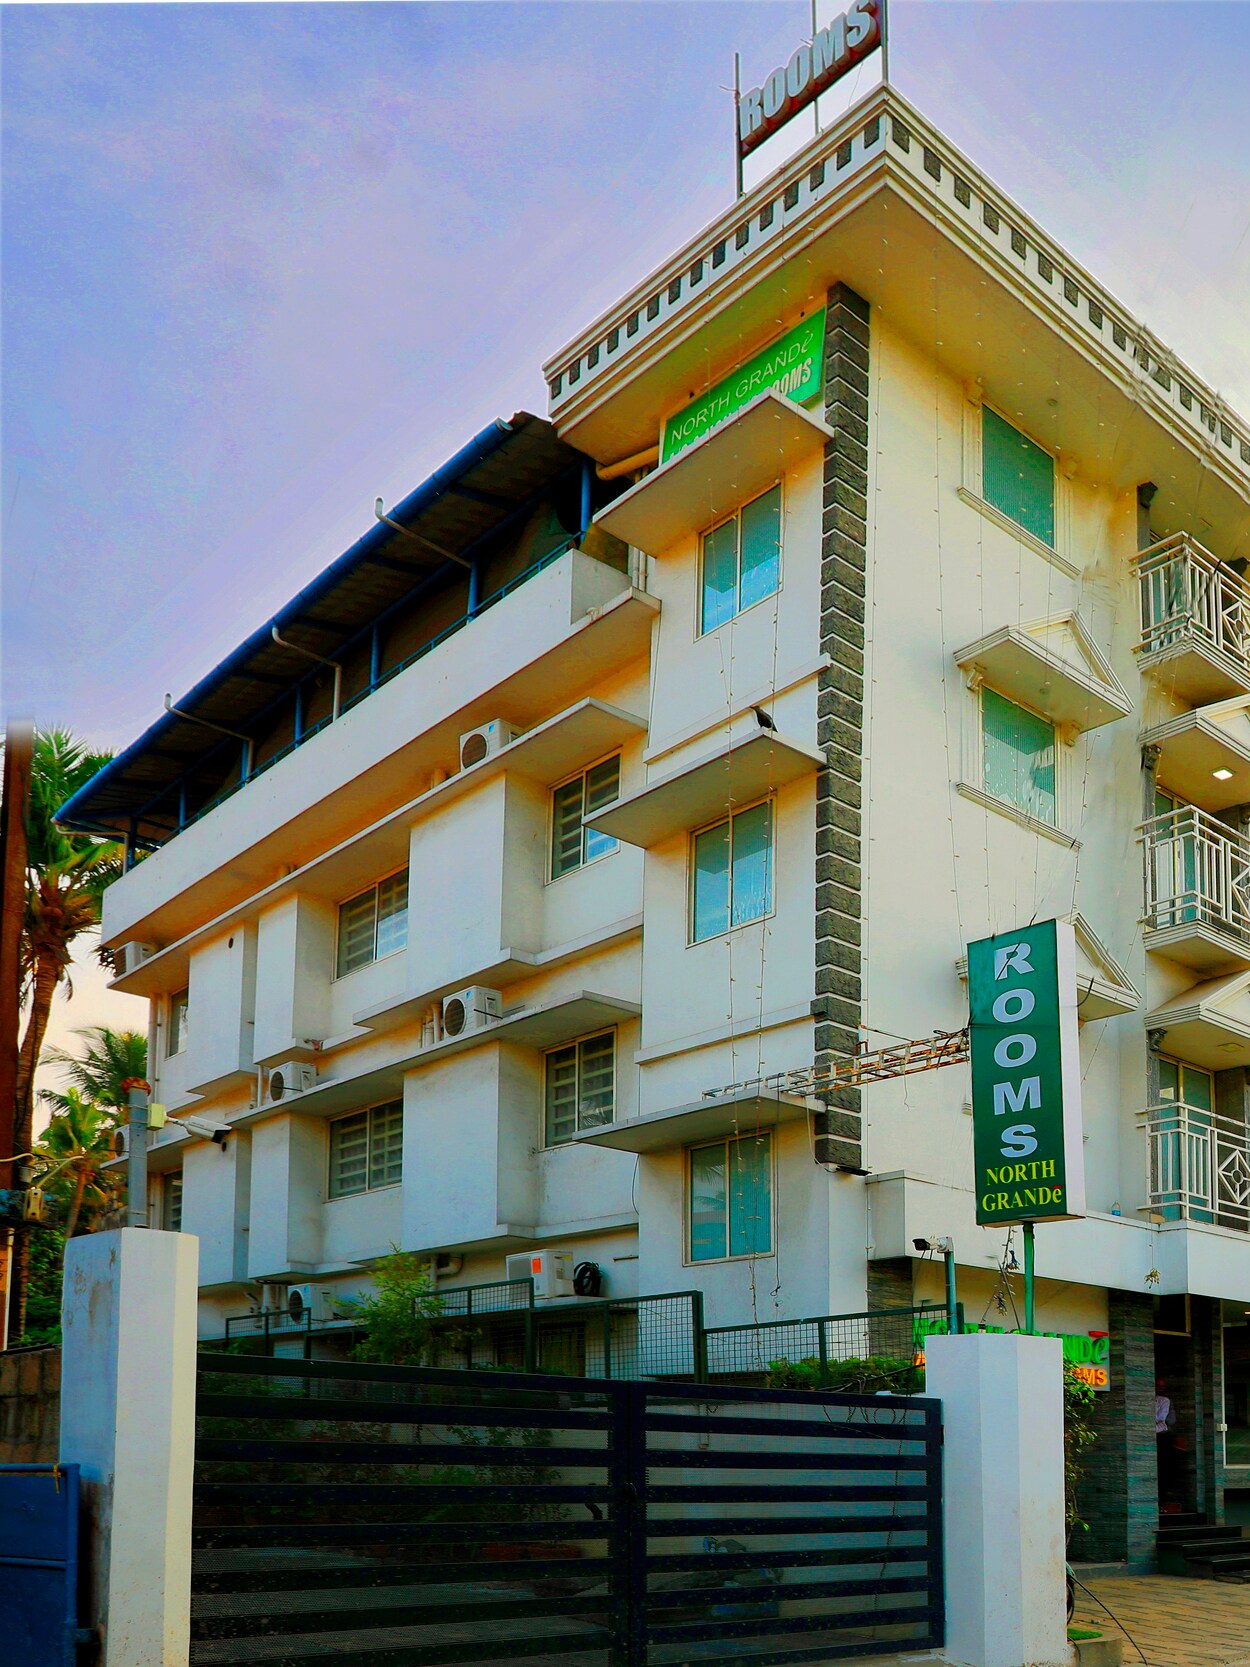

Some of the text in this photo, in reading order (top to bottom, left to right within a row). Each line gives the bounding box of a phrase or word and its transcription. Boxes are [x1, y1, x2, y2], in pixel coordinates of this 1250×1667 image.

[740, 0, 876, 141] ROOMS
[772, 357, 813, 396] OOMS
[671, 391, 731, 445] NORTH
[991, 941, 1042, 1159] ROOMS
[985, 1158, 1057, 1187] NORTH
